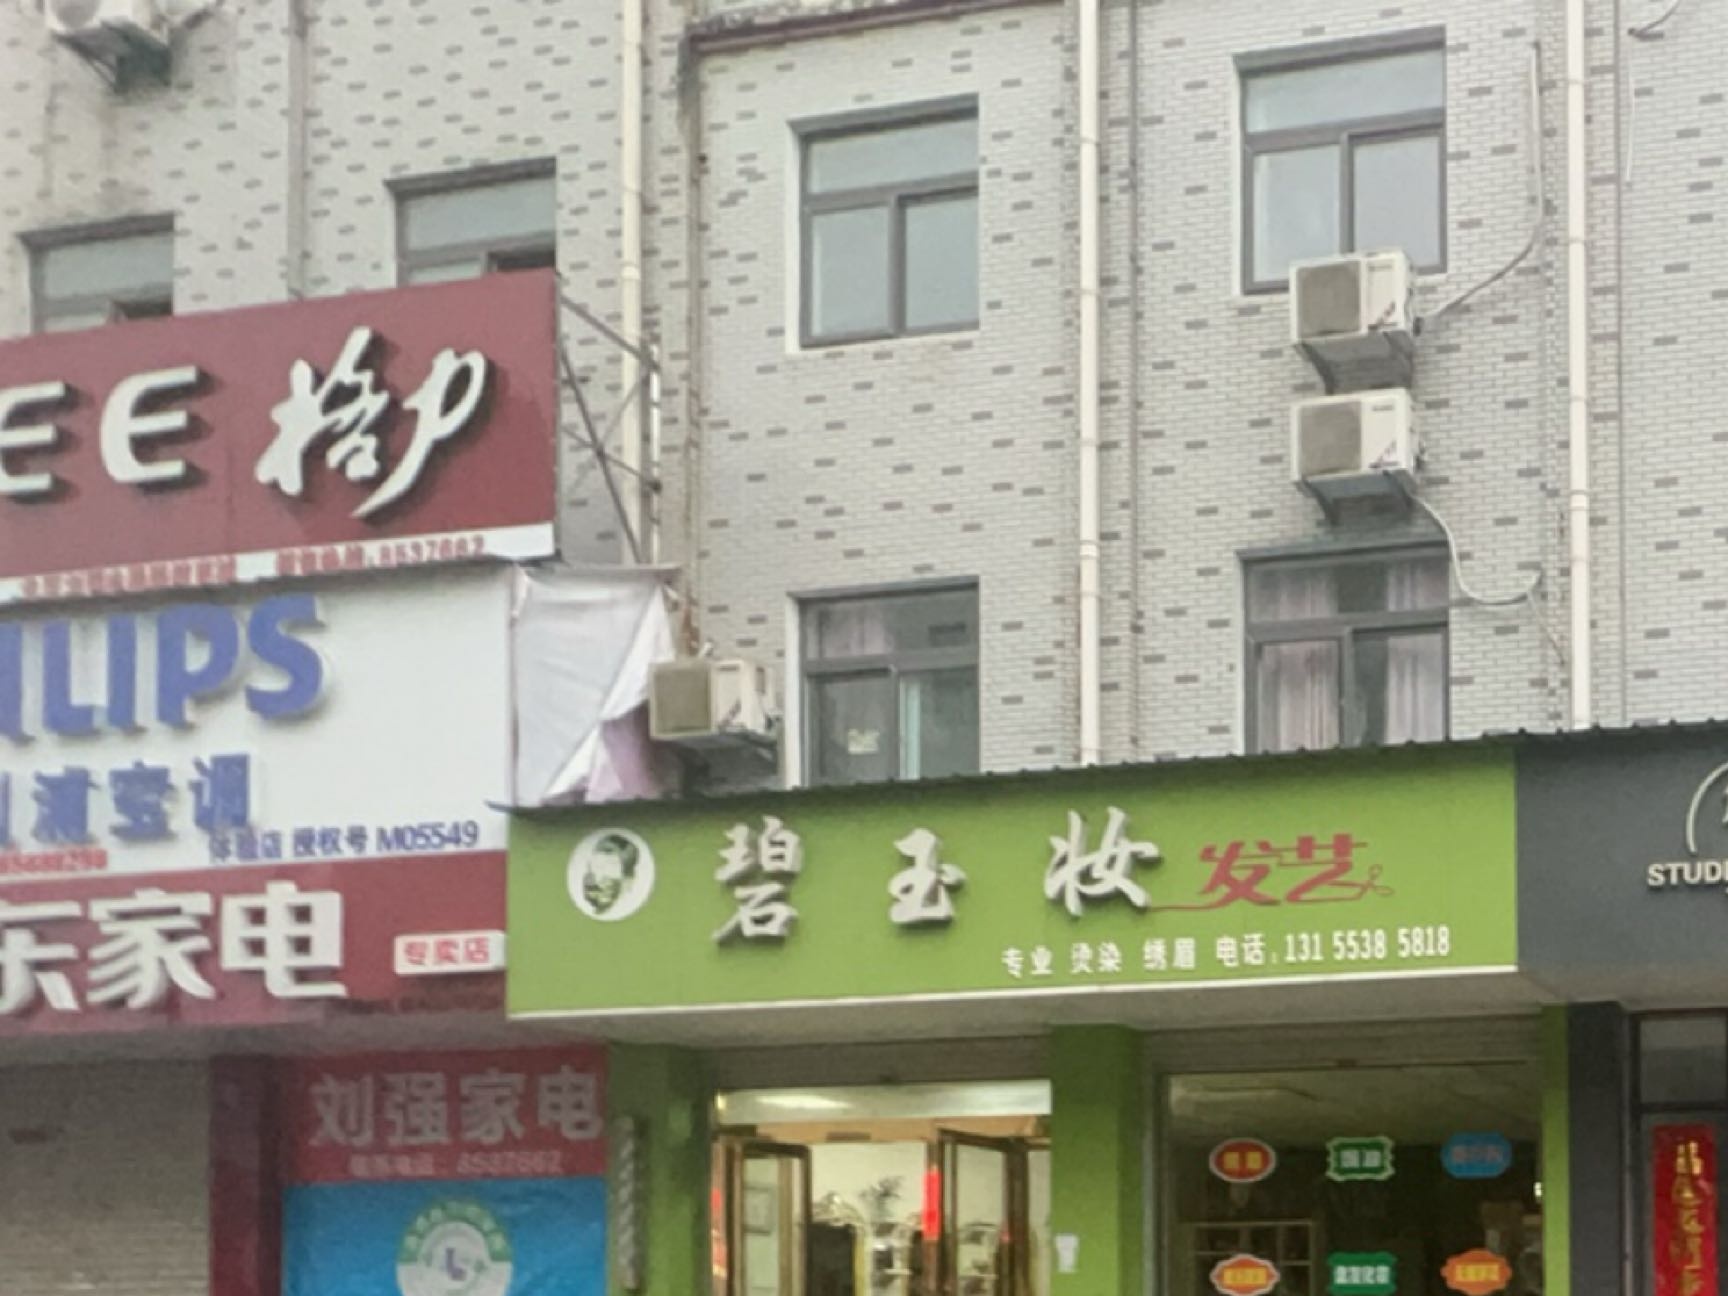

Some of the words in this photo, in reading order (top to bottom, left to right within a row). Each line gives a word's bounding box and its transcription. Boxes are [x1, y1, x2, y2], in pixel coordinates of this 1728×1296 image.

[254, 326, 486, 518] 格力
[0, 755, 249, 842] 浦空调
[293, 825, 368, 856] 授权号
[376, 820, 479, 851] M05549
[713, 806, 1161, 942] 碧玉妆
[1195, 833, 1388, 910] 发艺
[403, 937, 490, 966] 专卖店
[1001, 945, 1054, 979] 专业
[1070, 941, 1122, 975] 烫染
[1142, 937, 1197, 972] 绣眉
[1284, 931, 1324, 964] 131
[1332, 929, 1387, 961] 5538
[1397, 925, 1450, 958] 5818
[308, 1065, 604, 1147] 刘强家电
